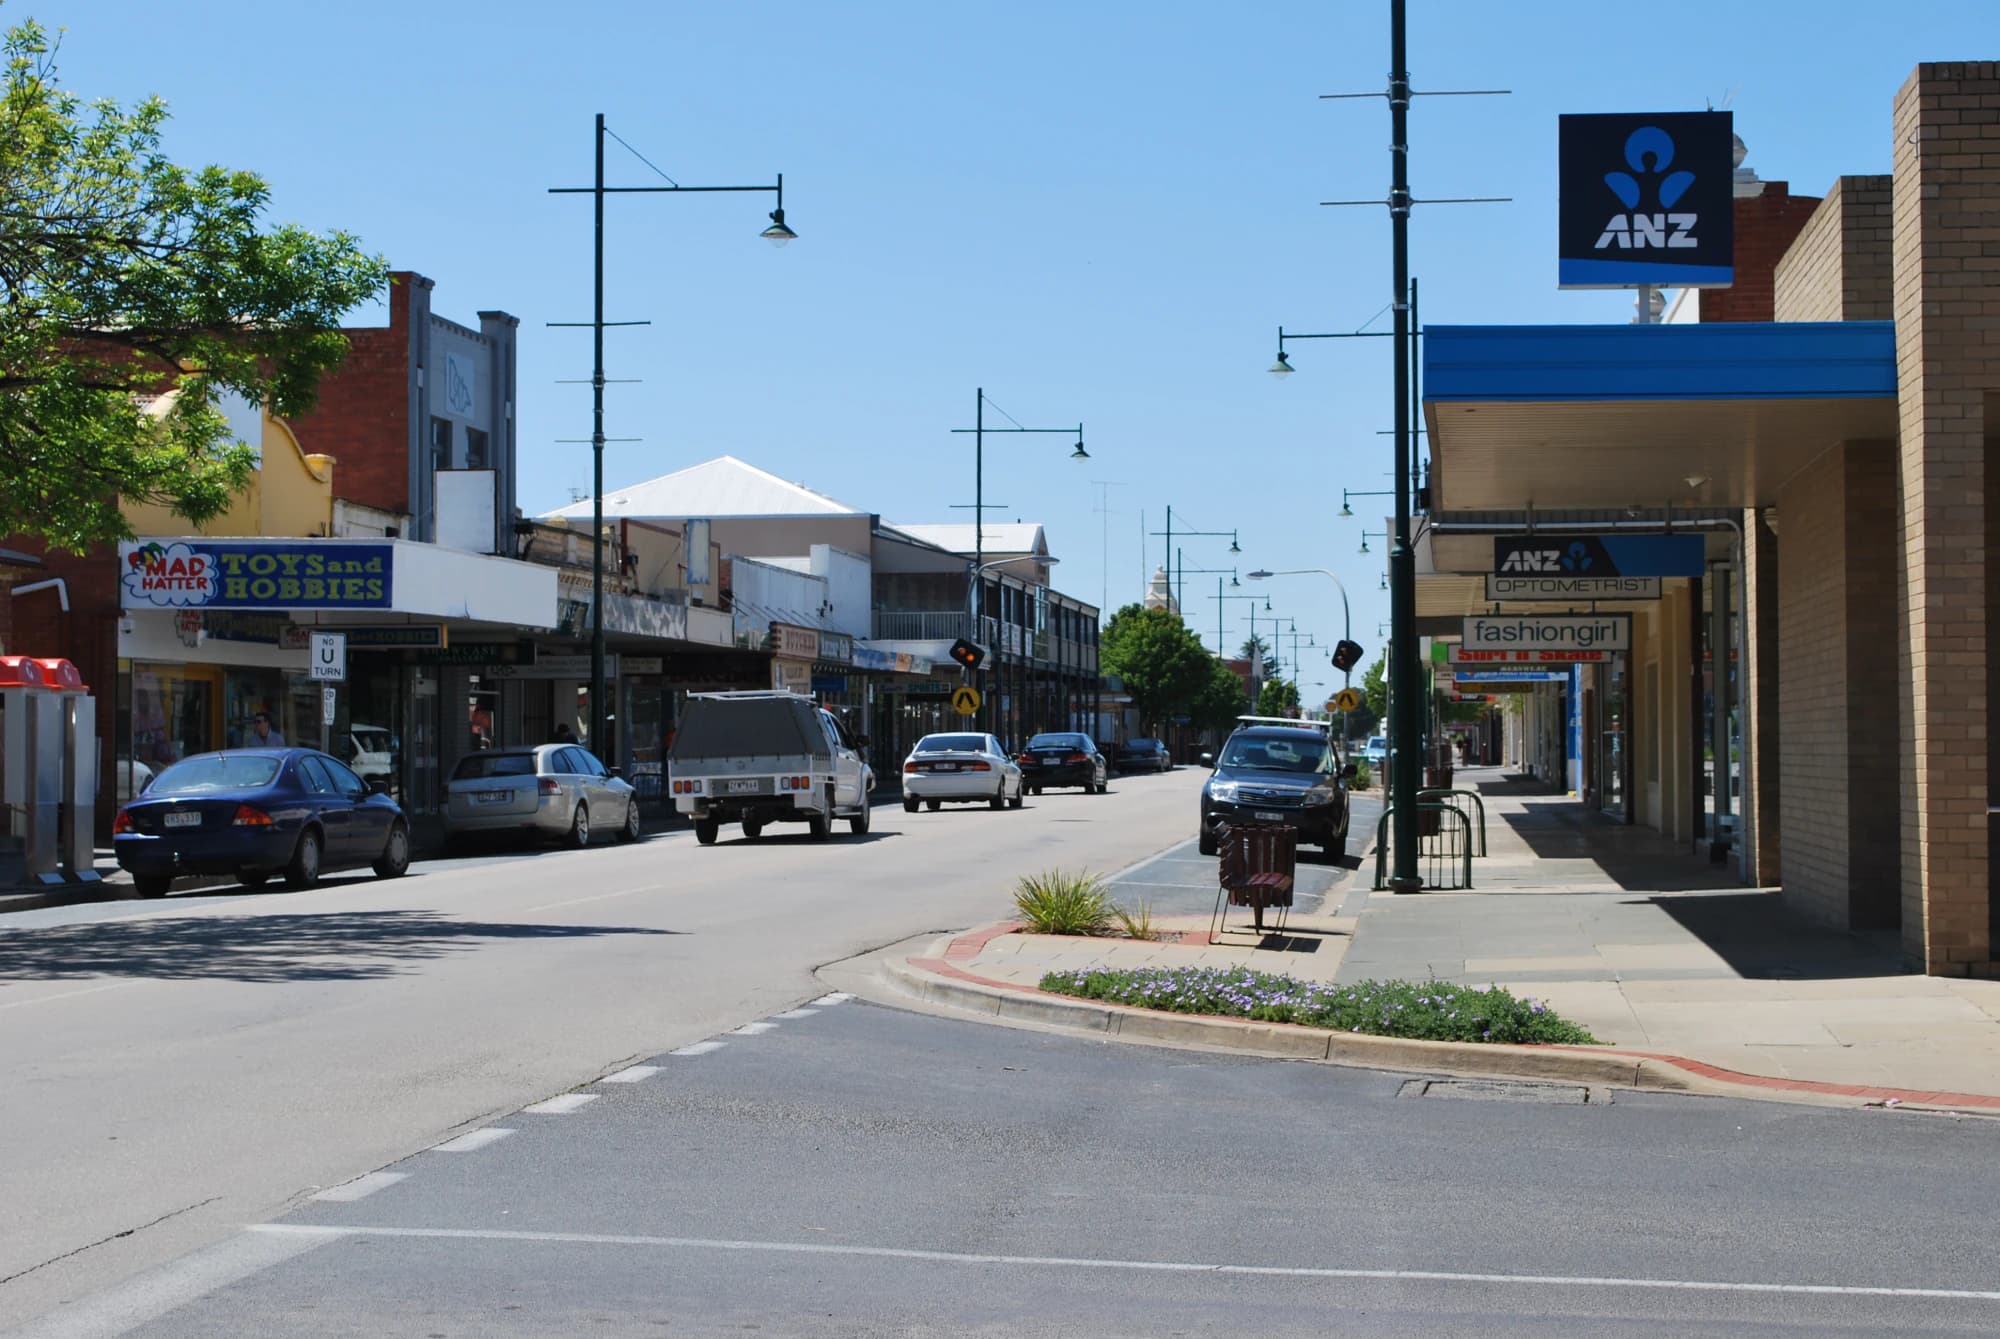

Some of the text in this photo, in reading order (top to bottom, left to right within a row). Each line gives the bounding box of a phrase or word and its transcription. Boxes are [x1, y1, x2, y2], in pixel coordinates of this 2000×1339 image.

[1594, 213, 1698, 249] ANZ
[146, 557, 205, 577] MAD
[221, 553, 383, 575] TOYS and
[1501, 550, 1561, 572] ANZ
[143, 577, 208, 591] HATTER
[225, 578, 384, 600] HOBBIES
[1495, 578, 1652, 593] OPTOMETRIST
[322, 638, 334, 647] NO
[1474, 620, 1618, 647] fashiongirl
[322, 649, 334, 664] U
[314, 667, 341, 676] TURN
